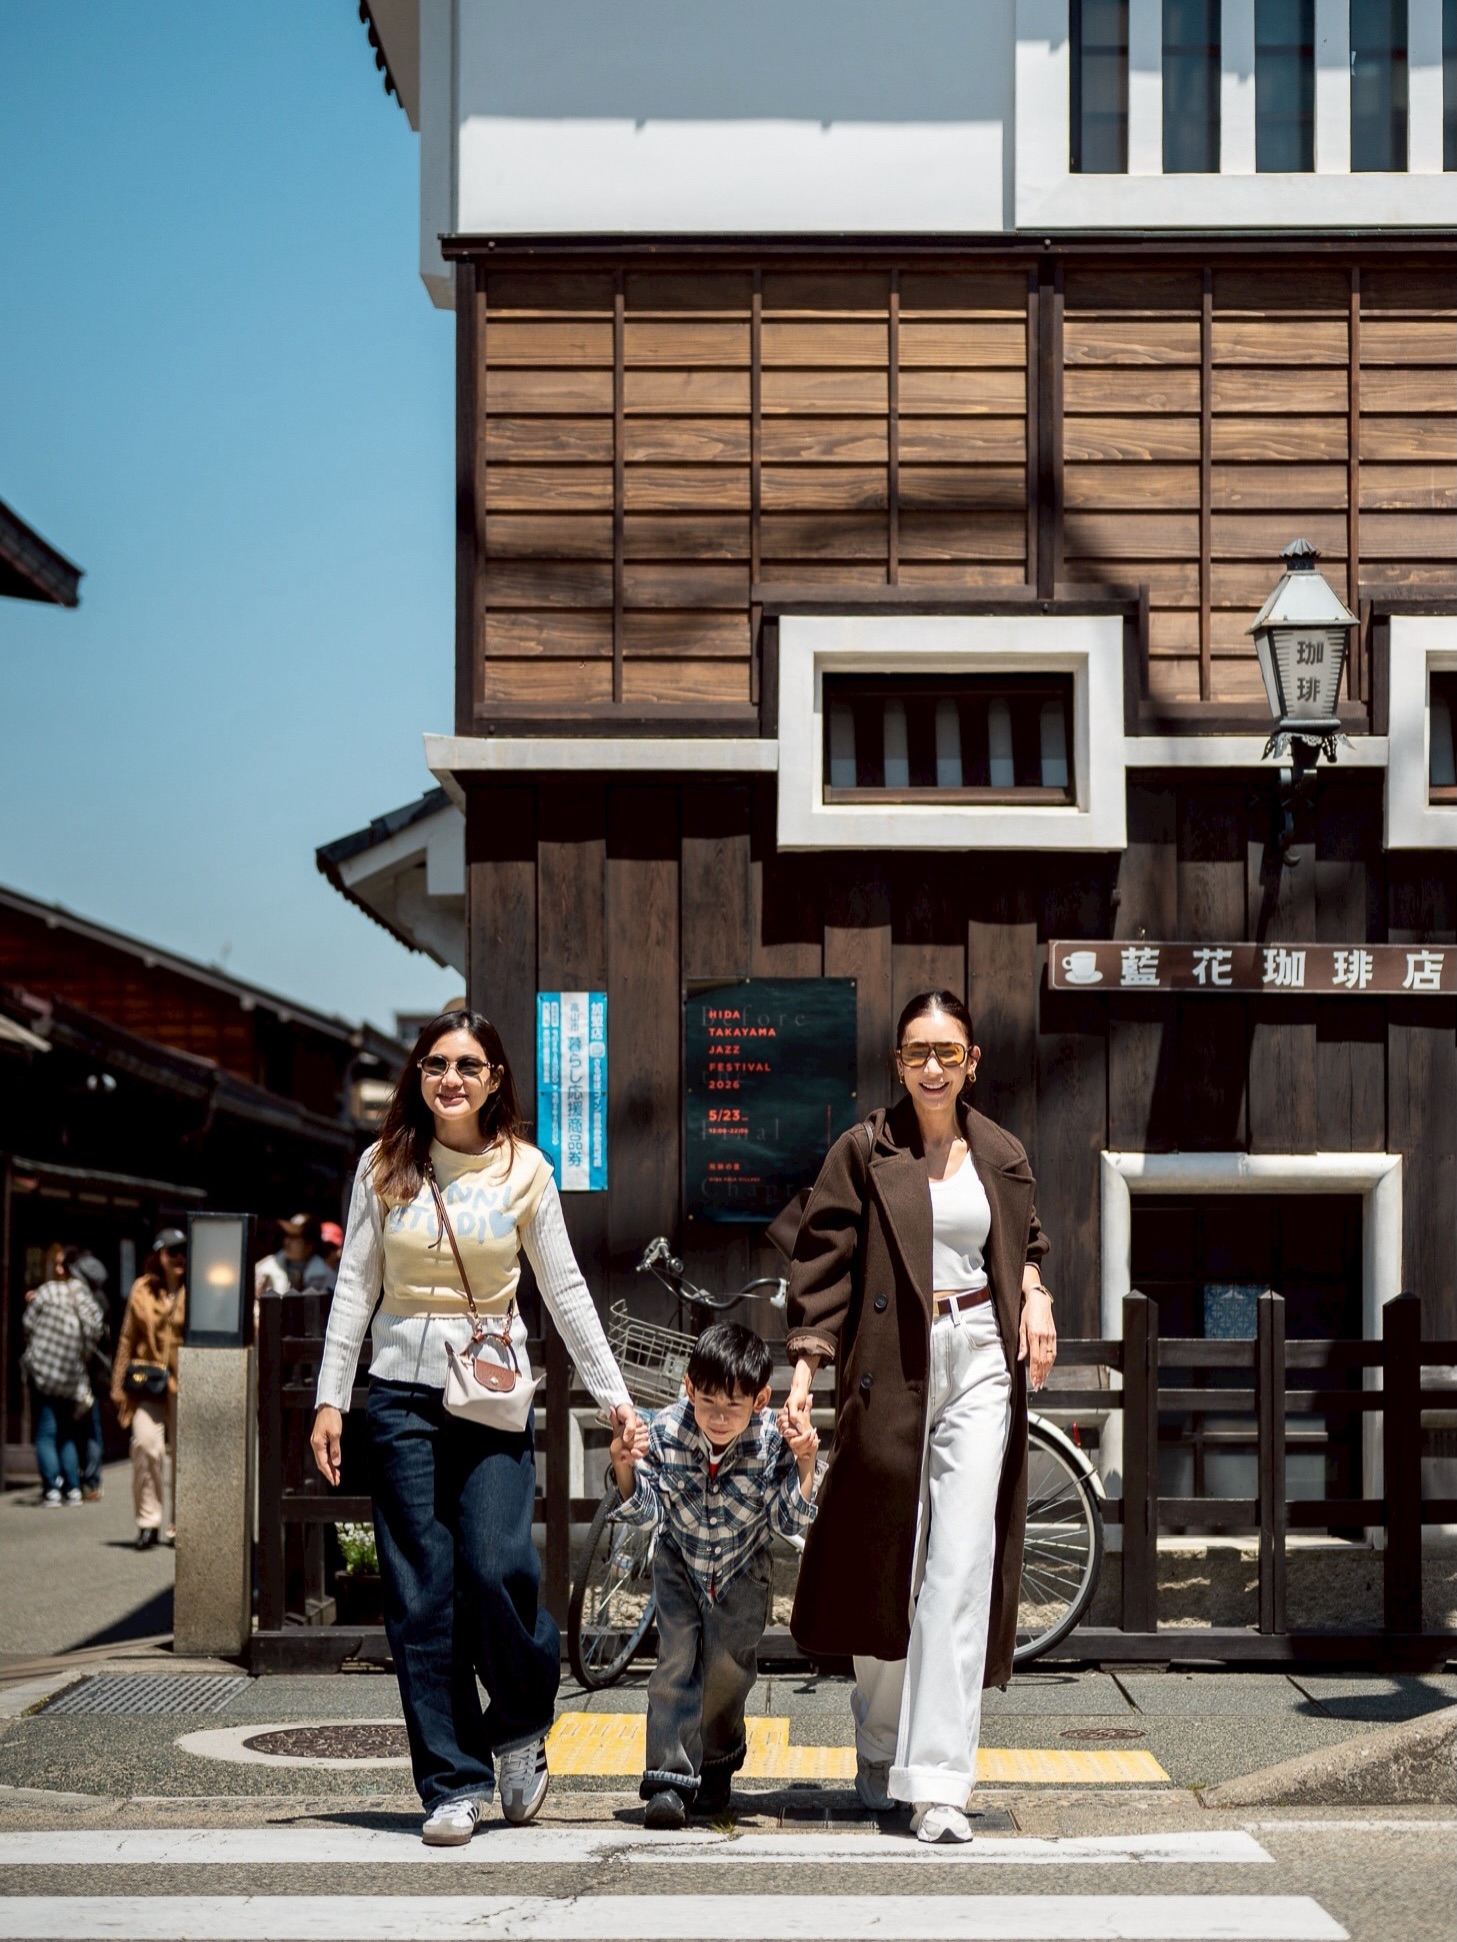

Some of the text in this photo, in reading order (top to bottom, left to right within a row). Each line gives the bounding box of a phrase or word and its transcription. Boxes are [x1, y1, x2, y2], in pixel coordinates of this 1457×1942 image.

[1296, 641, 1325, 703] 珈琲
[1120, 946, 1445, 991] 藍花珈琲店
[708, 1009, 741, 1020] HIDA
[708, 1027, 777, 1037] TAKAYAMA
[708, 1044, 741, 1055] JAZZ
[708, 1062, 772, 1072] FESTIVAL
[708, 1080, 741, 1090] 2026
[708, 1108, 741, 1122] 5/23
